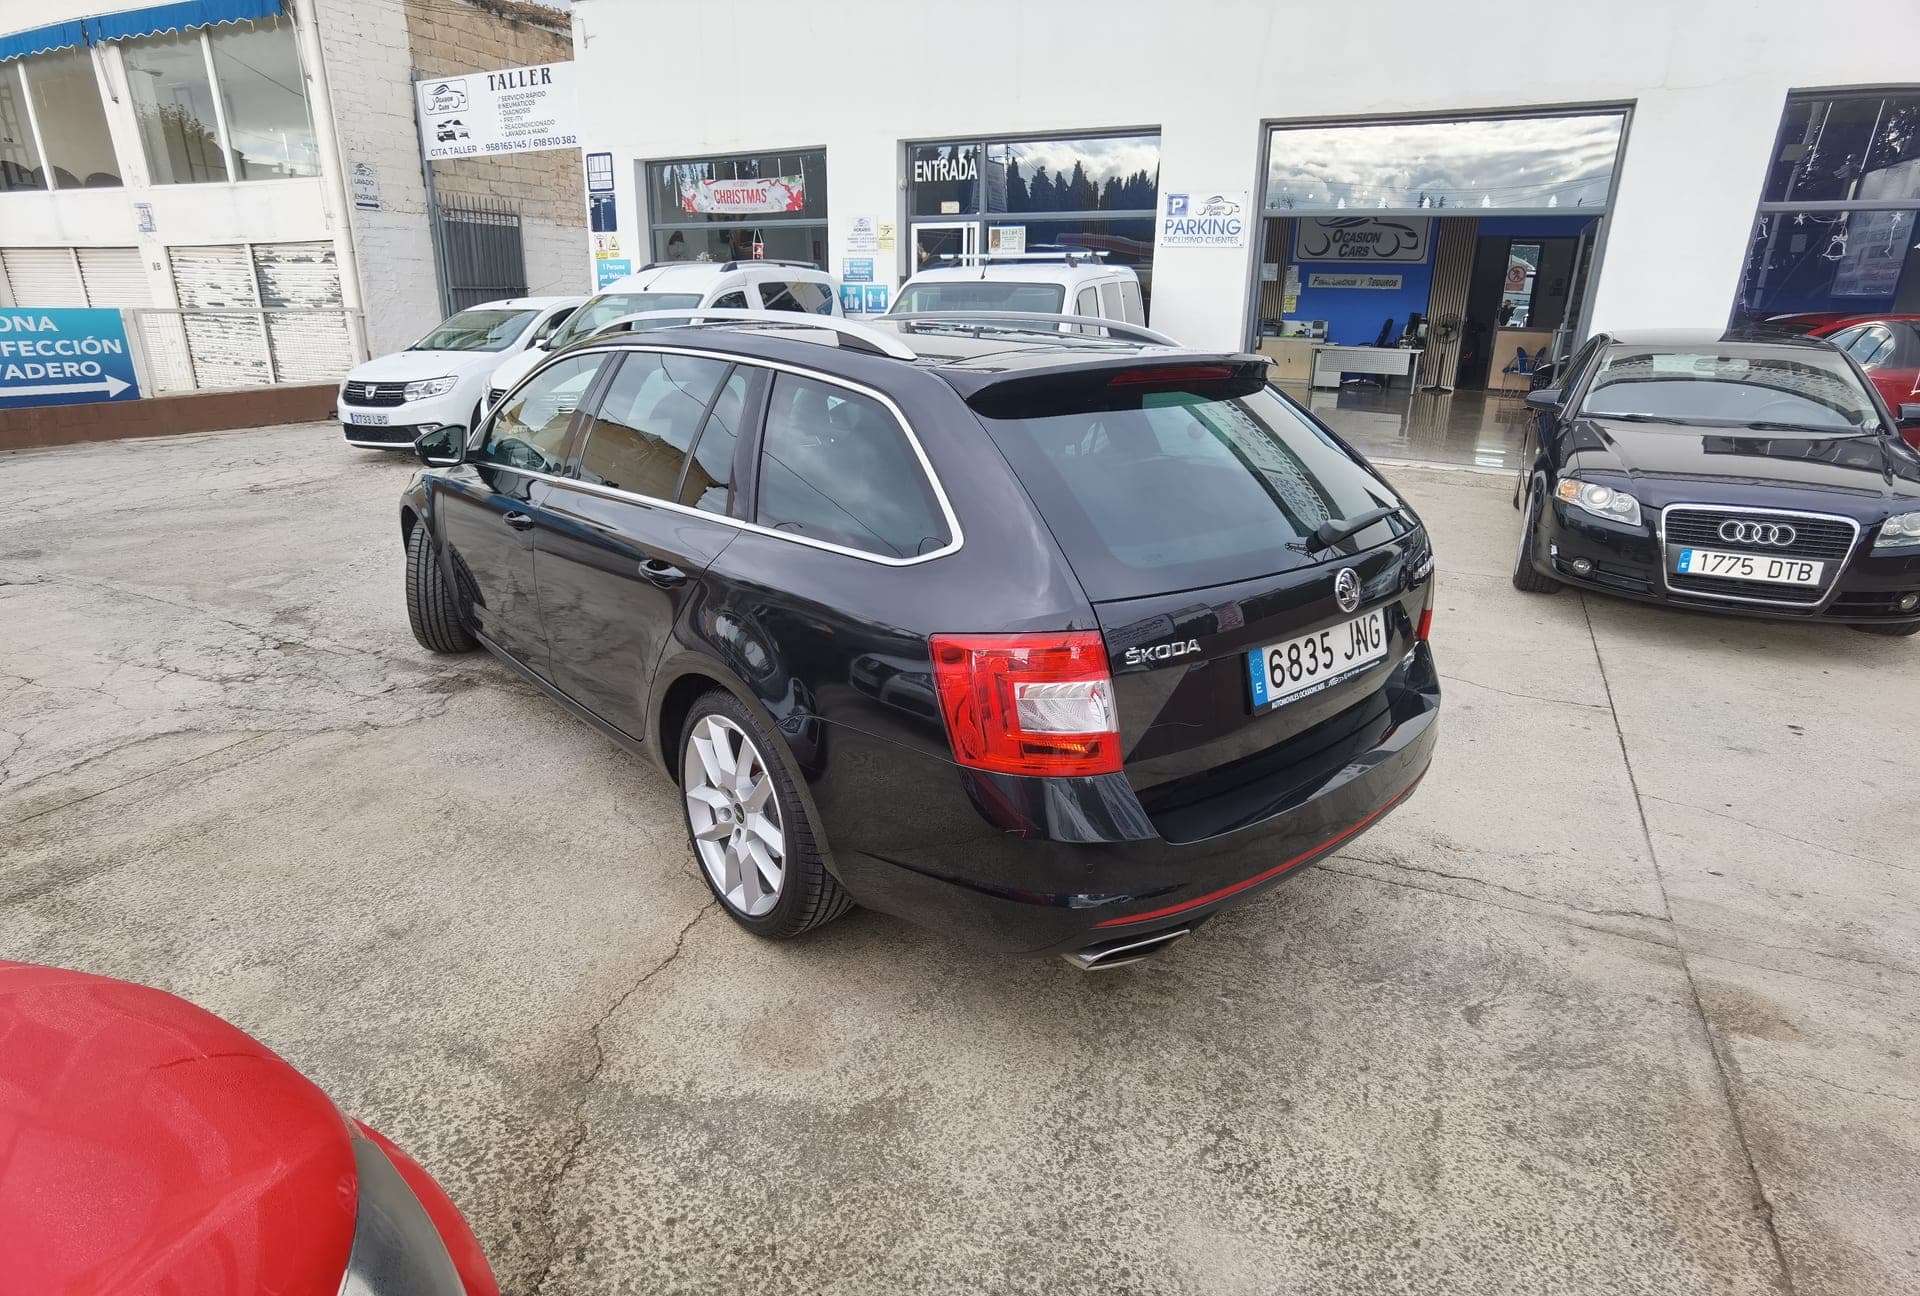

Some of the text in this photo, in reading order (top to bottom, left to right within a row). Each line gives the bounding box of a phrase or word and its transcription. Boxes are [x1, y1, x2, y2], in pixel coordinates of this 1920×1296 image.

[487, 67, 552, 91] TALLER
[430, 148, 448, 156] CITA
[448, 145, 477, 154] TALLER
[914, 158, 978, 182] ENTRADA
[713, 188, 767, 204] CHRISTMAS
[1172, 198, 1184, 214] P
[1164, 218, 1242, 235] PARKING
[1163, 236, 1239, 244] EXCLUSIVO CLIENTES
[1332, 229, 1382, 243] OCASION
[1338, 244, 1370, 257] CARS
[0, 361, 101, 380] ADERO
[354, 414, 372, 424] 2733
[1700, 553, 1754, 576] 1775
[1767, 560, 1814, 582] DTB
[1125, 638, 1201, 665] ŠKODA
[1269, 631, 1334, 688] 6835
[1344, 614, 1381, 660] JNG
[1256, 682, 1263, 694] E
